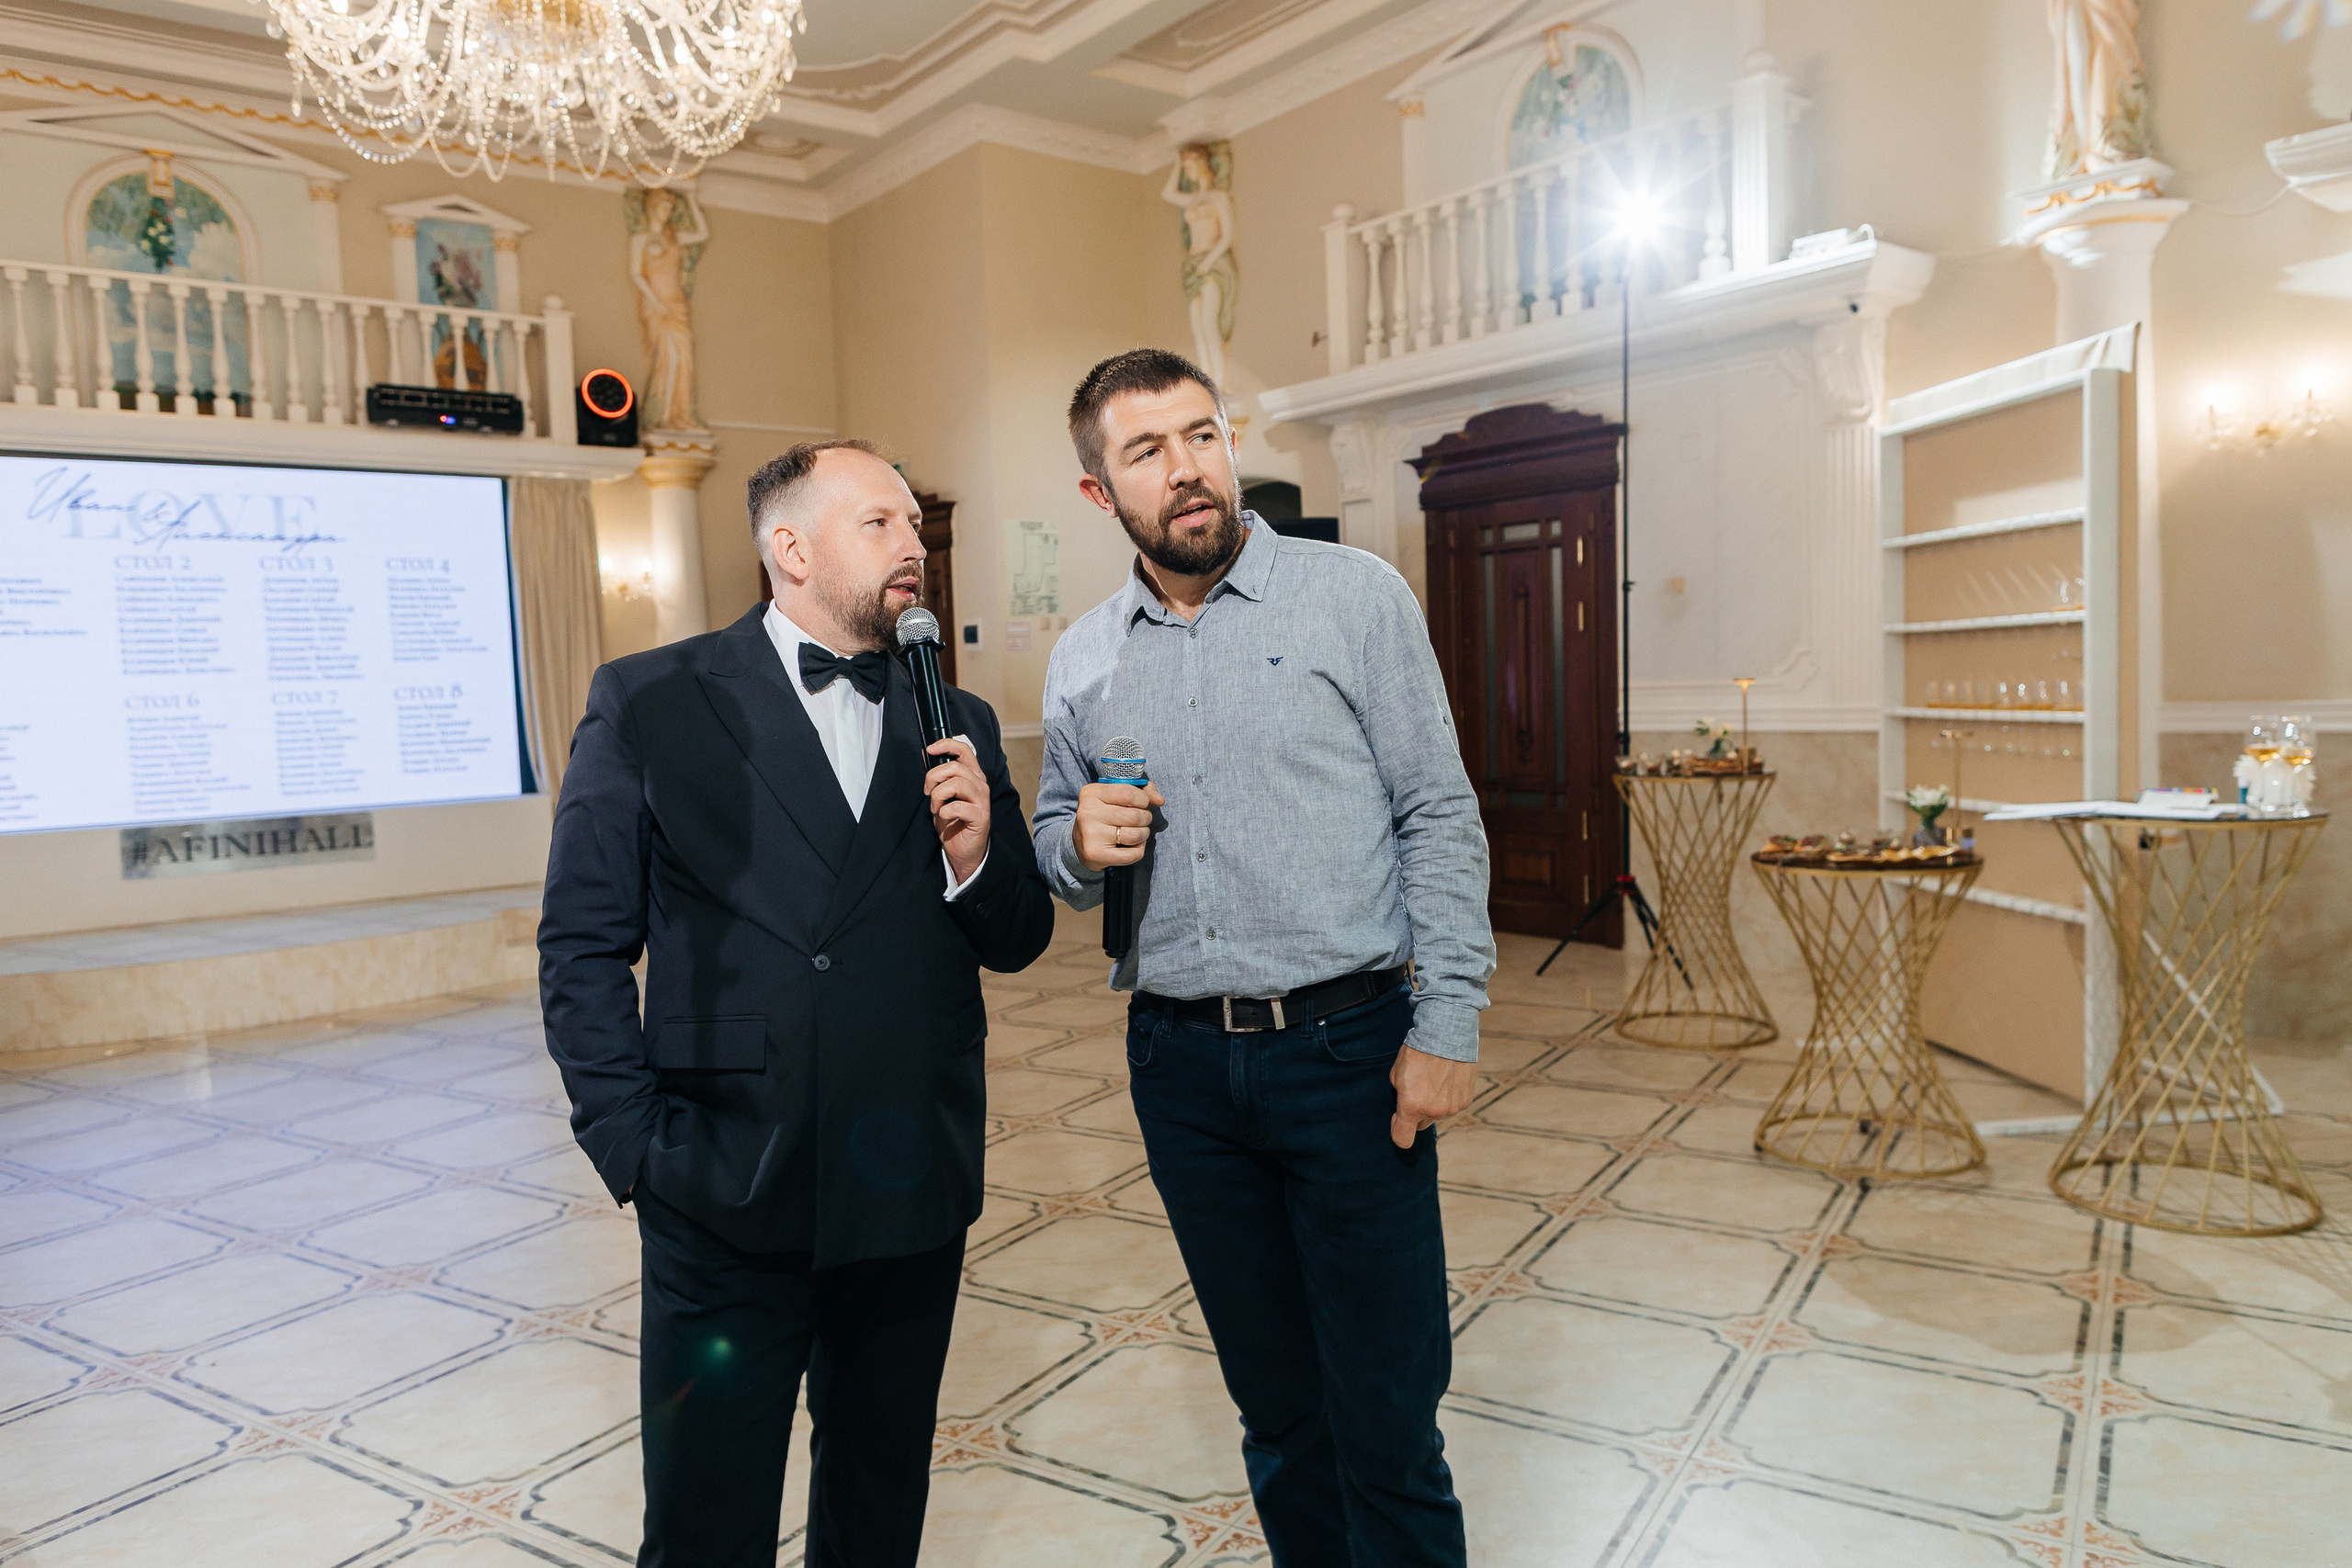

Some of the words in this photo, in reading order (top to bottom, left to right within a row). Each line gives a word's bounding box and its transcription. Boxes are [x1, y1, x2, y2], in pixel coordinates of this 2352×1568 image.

[64, 489, 321, 540] LOVE
[114, 555, 173, 570] СТОЛ
[259, 556, 316, 570] СТОЛ
[385, 557, 435, 571] СТОЛ
[271, 691, 323, 705] СТОЛ
[393, 685, 445, 701] СТОЛ
[125, 694, 181, 709] СТОЛ
